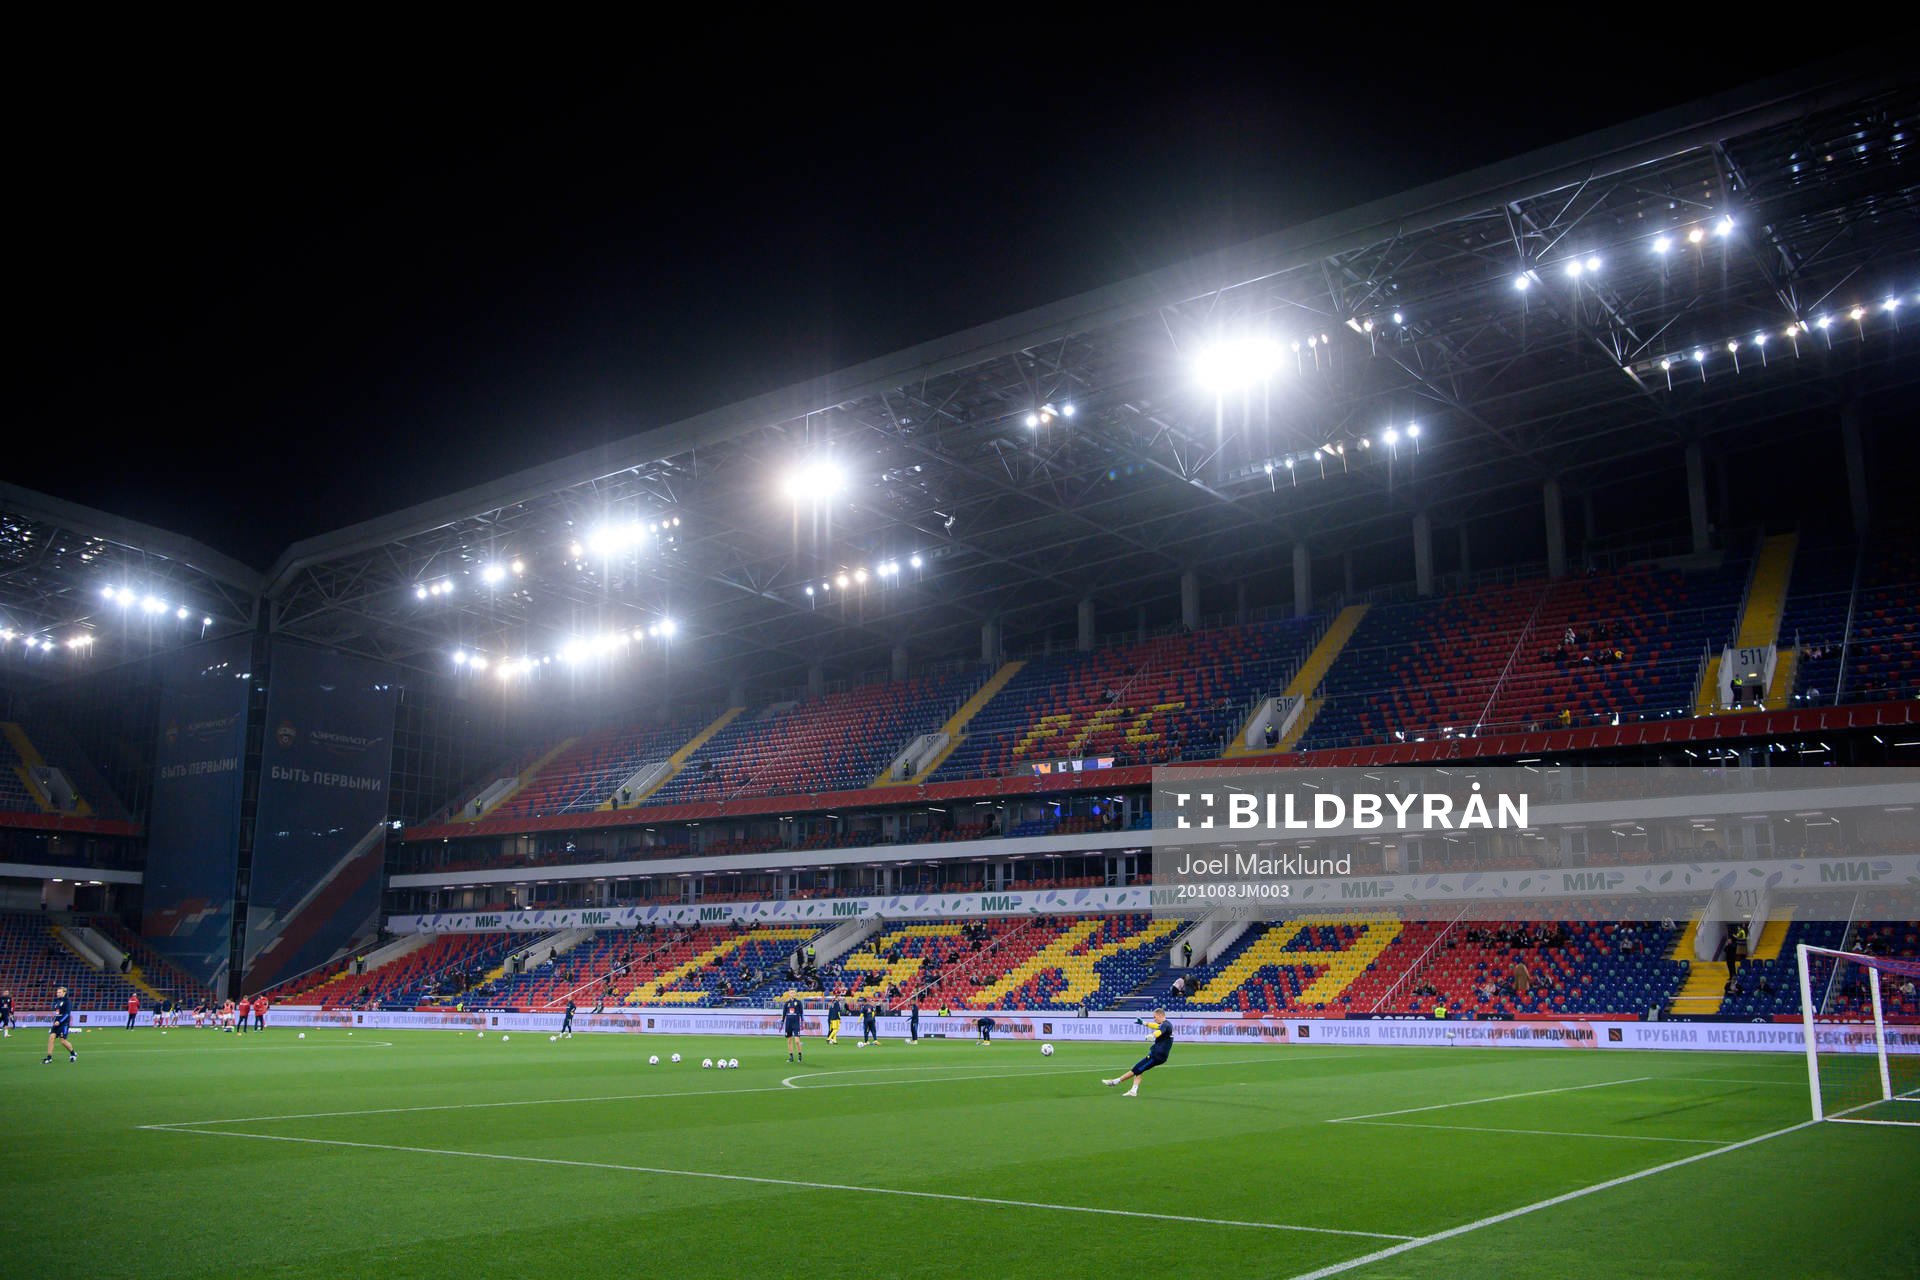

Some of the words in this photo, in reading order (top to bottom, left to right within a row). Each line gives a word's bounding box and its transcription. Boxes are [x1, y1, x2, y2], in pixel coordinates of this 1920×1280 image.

[1741, 648, 1763, 666] 511
[188, 757, 238, 775] ПЕРВЫМИ
[271, 765, 310, 783] БЫТЬ
[313, 771, 382, 792] ПЕРВЫМИ
[1819, 861, 1893, 883] МИР
[1341, 880, 1395, 899] МИР
[1563, 872, 1625, 891] МИР
[981, 895, 1023, 911] МИР
[1734, 889, 1758, 907] 211
[700, 907, 732, 922] МИР
[833, 901, 869, 916] МИР
[475, 916, 502, 929] МИР
[582, 911, 610, 925] МИР
[661, 1019, 691, 1028] ТРУБНАЯ
[1062, 1023, 1103, 1034] ТРУБНАЯ
[1236, 1026, 1287, 1038] ПРОДУКЦИИ
[1320, 1026, 1371, 1038] ТРУБНАЯ
[1532, 1029, 1594, 1042] ПРОДУКЦИИ
[1636, 1028, 1698, 1043] ТРУБНАЯ
